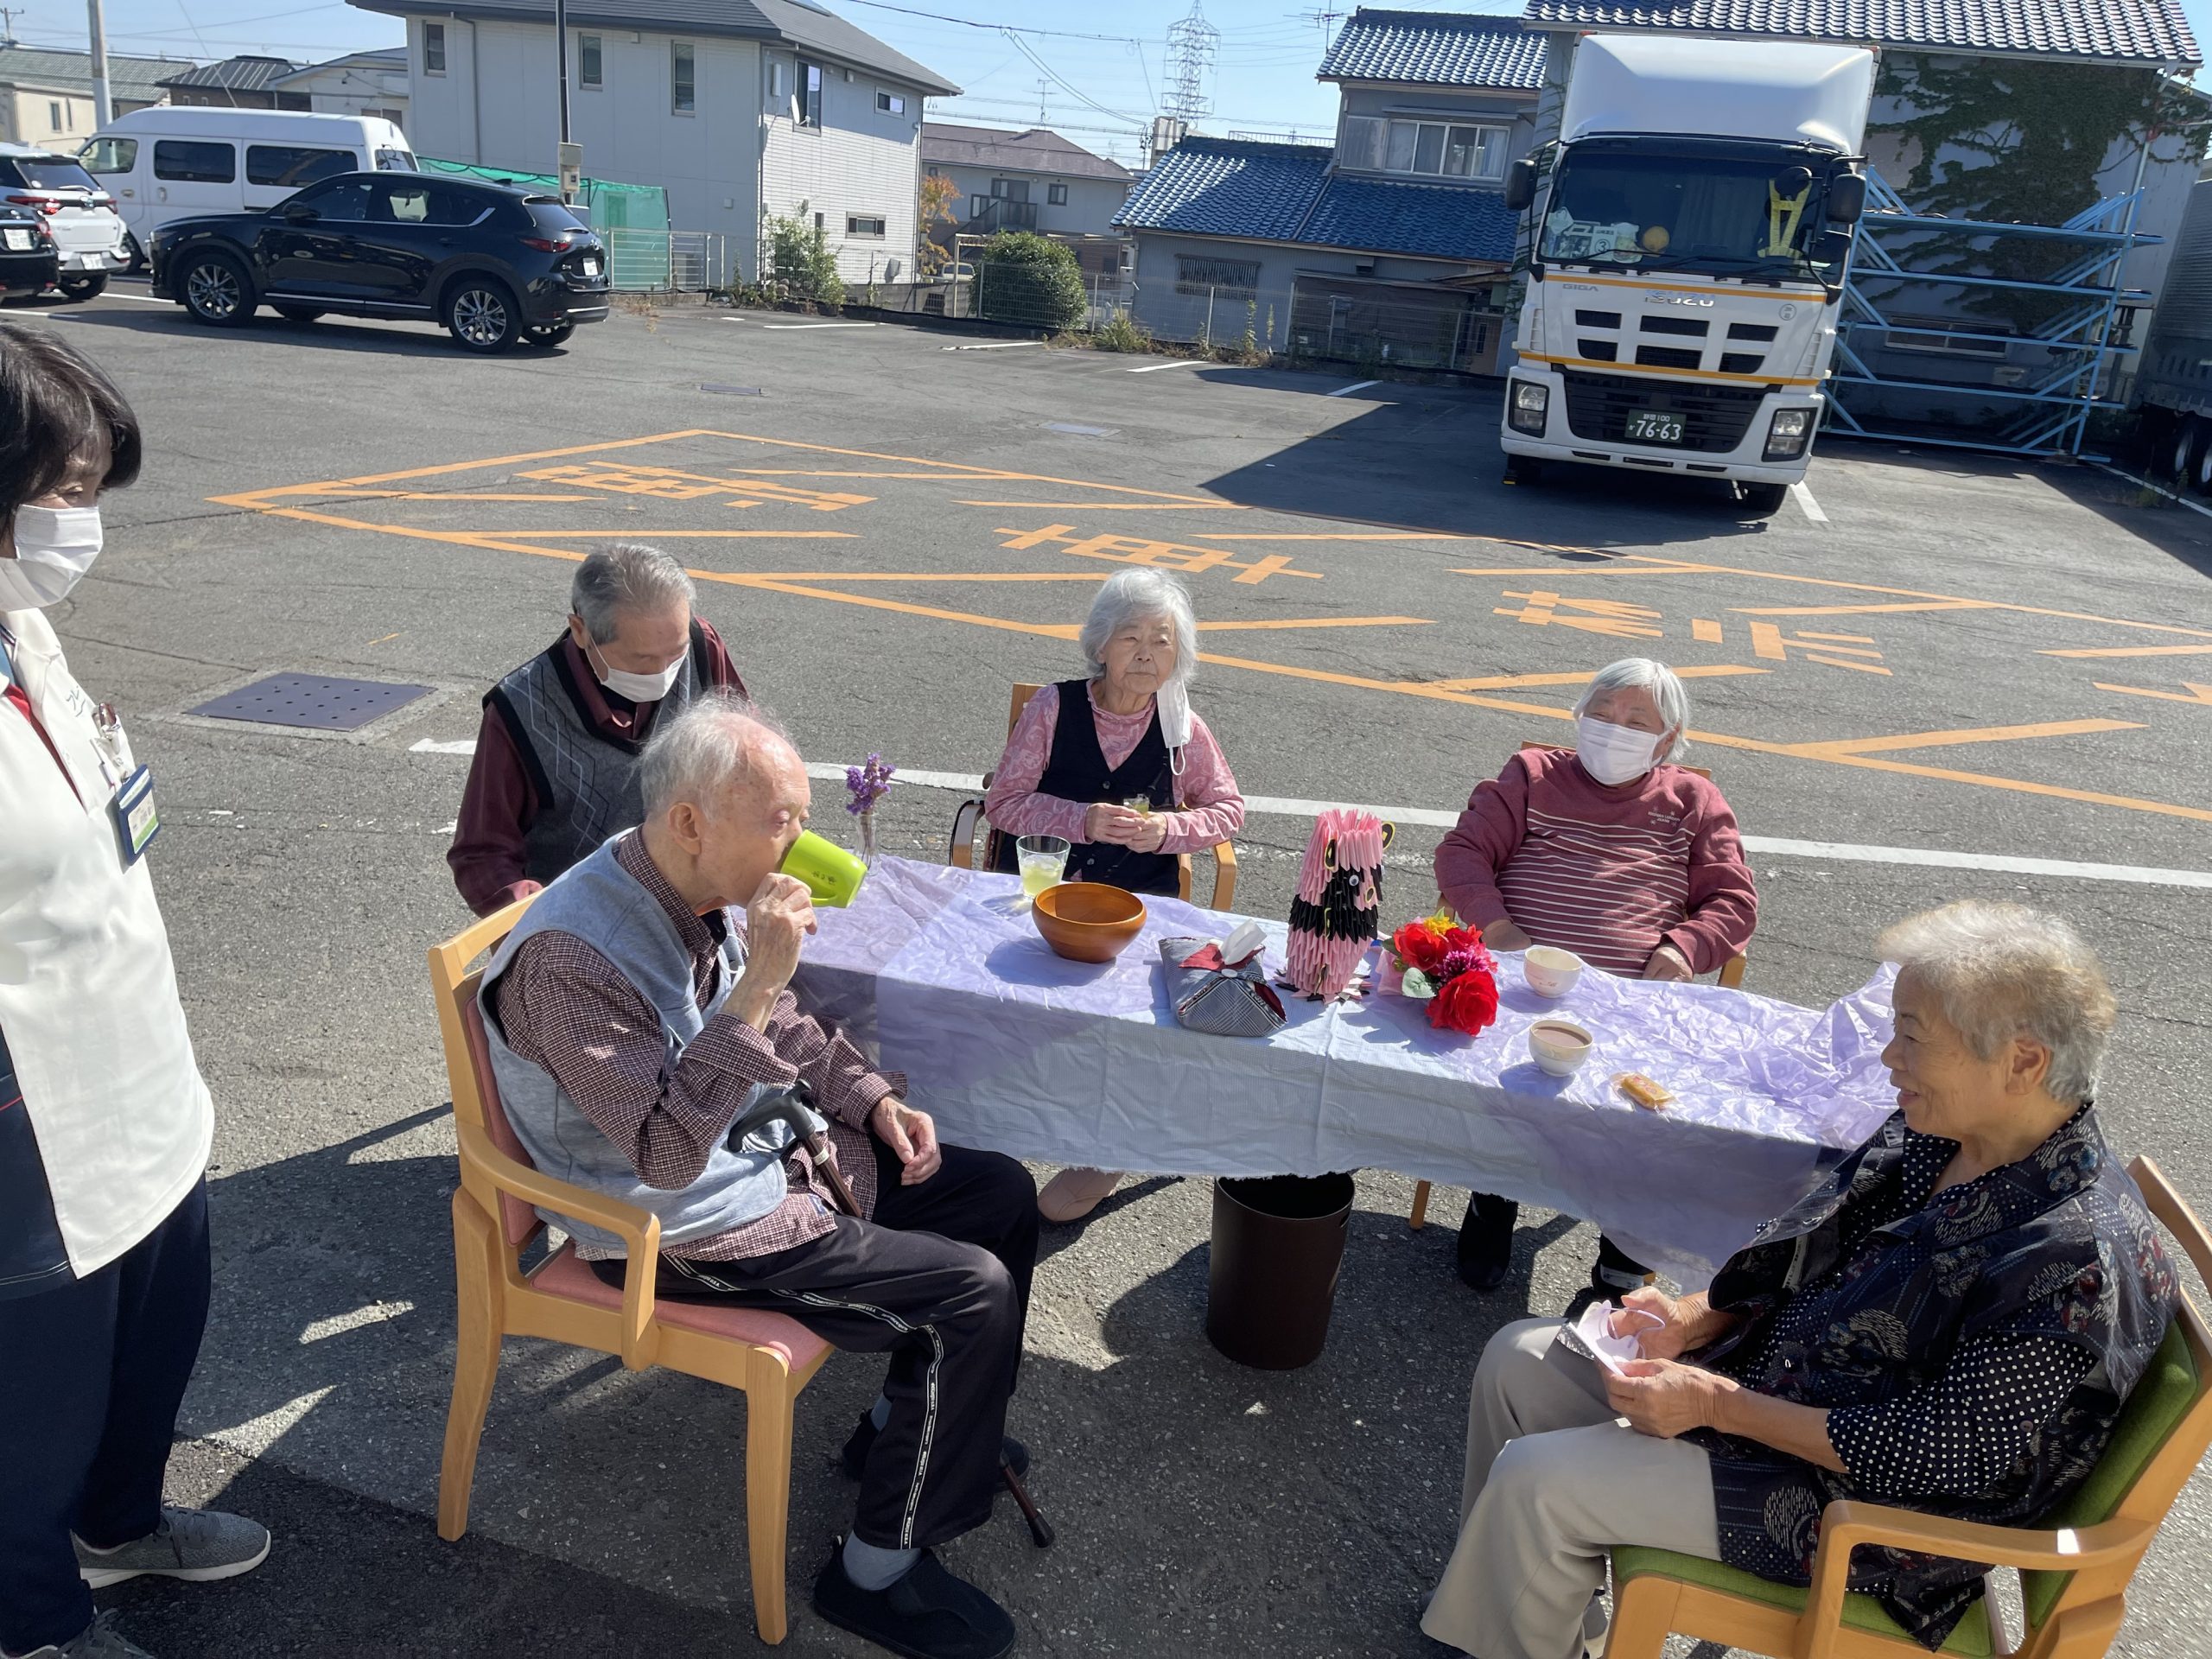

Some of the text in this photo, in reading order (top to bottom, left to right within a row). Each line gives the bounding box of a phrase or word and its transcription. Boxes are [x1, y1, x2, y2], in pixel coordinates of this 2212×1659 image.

[1562, 283, 1599, 292] GIGA
[1644, 289, 1715, 308] ISUZU
[1635, 419, 1682, 441] 76-63
